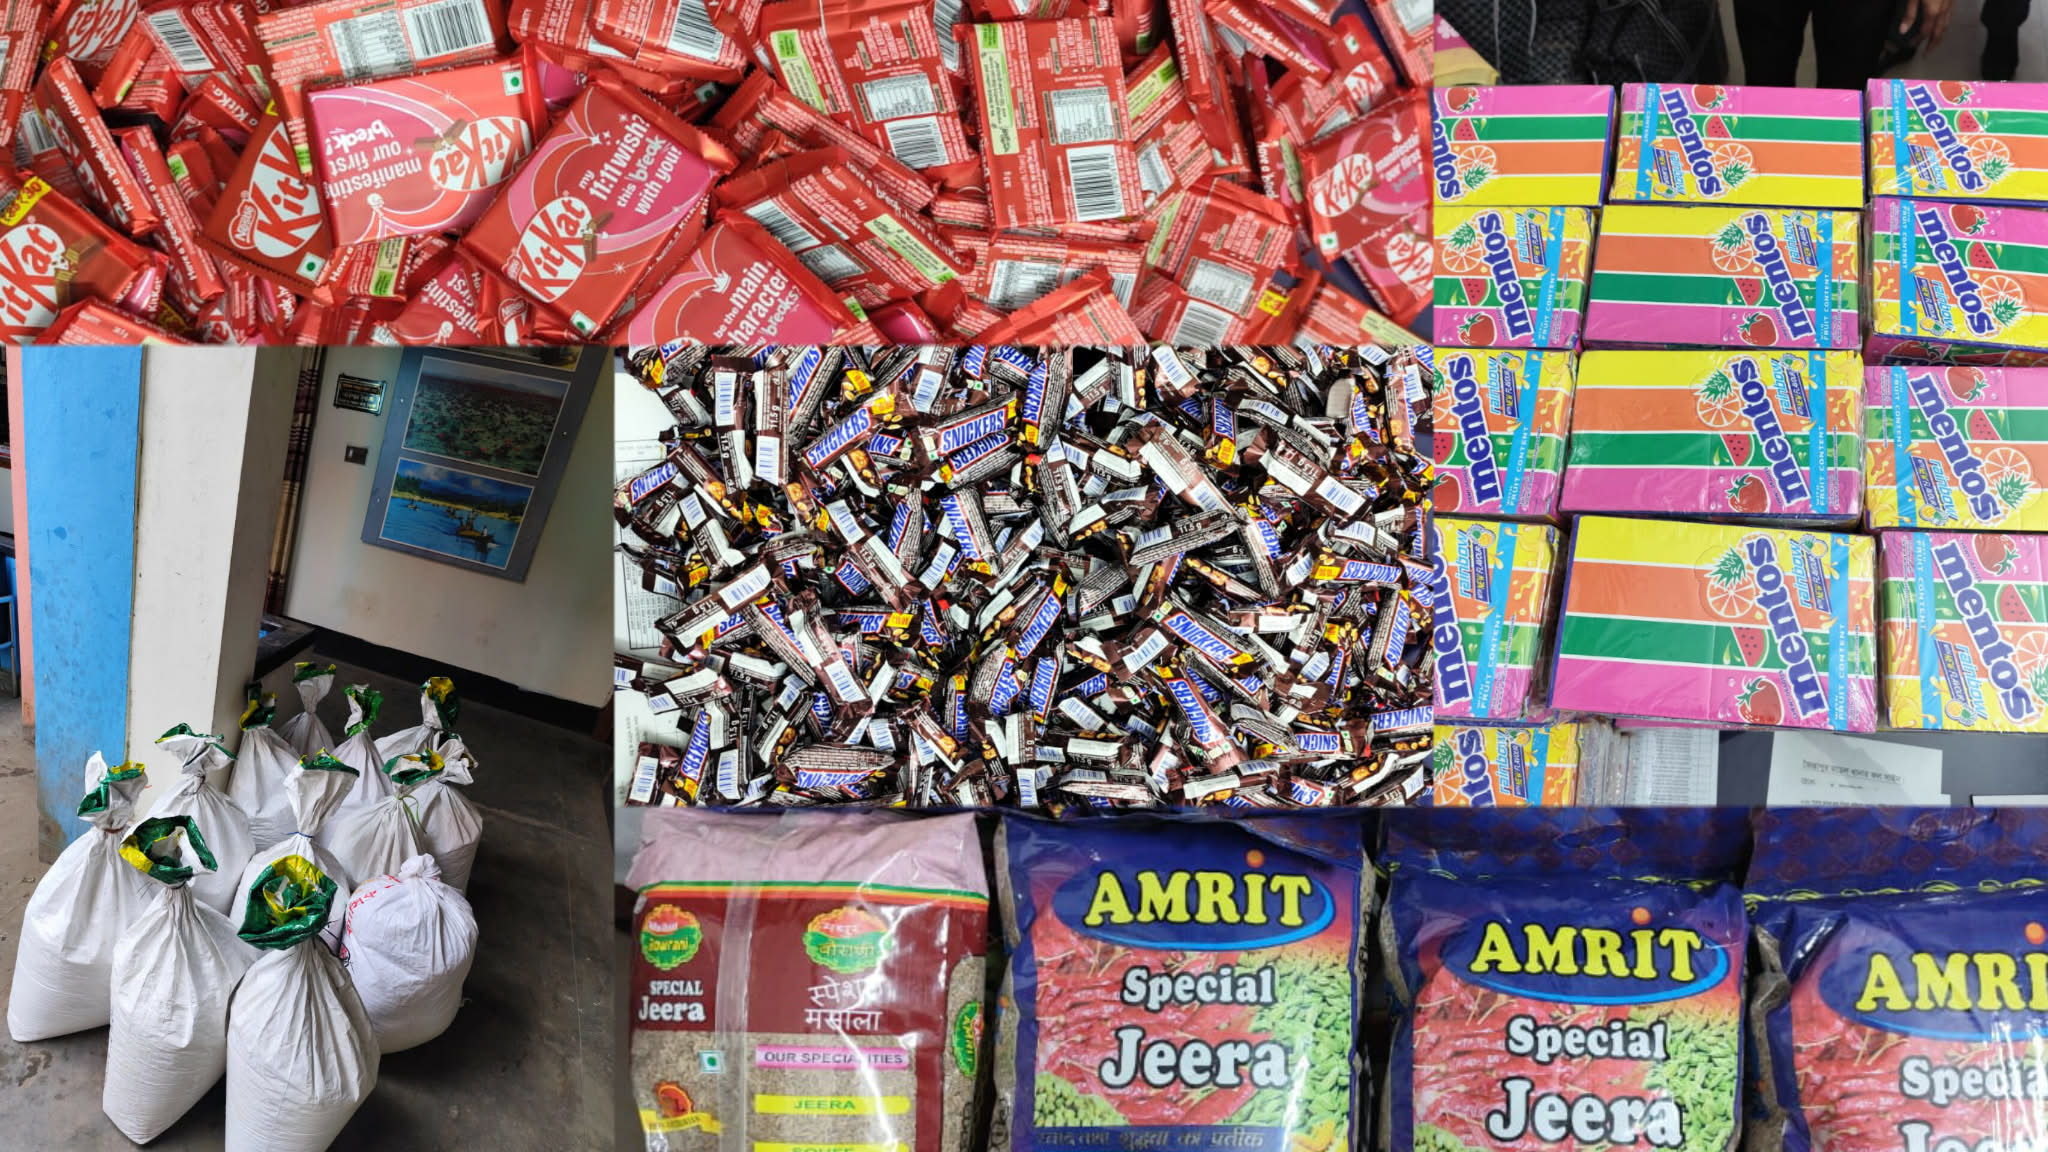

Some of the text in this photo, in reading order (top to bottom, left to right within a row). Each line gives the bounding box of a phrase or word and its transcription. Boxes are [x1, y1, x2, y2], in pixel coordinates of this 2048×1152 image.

[328, 141, 401, 177] our first
[433, 118, 530, 189] KitKat
[589, 114, 650, 201] 11:11 wish?
[1662, 89, 1722, 197] mentos
[1908, 85, 1983, 190] mentos
[578, 169, 595, 189] my
[616, 135, 666, 207] this break
[635, 181, 662, 215] with
[1318, 156, 1371, 215] KitKat
[330, 256, 349, 282] Have
[520, 199, 586, 297] KitKat
[1481, 213, 1533, 338] mentos
[1747, 214, 1813, 340] mentos
[1918, 210, 1995, 335] mentos
[713, 261, 769, 339] be the main
[1546, 272, 1555, 312] CONTENT
[1488, 358, 1502, 415] rainbow
[1771, 360, 1793, 415] rainbow
[807, 407, 870, 467] SNICKERS
[942, 409, 1006, 453] SNICKERS
[1451, 357, 1502, 504] mentos
[1733, 359, 1809, 505] mentos
[1908, 373, 2001, 522] mentos
[631, 463, 678, 502] SNICKE
[1510, 426, 1528, 505] FRUIT CONTENT
[1930, 459, 1957, 520] rainbow
[1344, 560, 1401, 582] SNICKERS
[1457, 532, 1472, 598] rainbow
[1791, 542, 1812, 608] rainbow
[1017, 595, 1061, 657] SNICKERS
[1747, 537, 1828, 718] mentos
[1918, 576, 1927, 630] CONTENT
[1933, 540, 2037, 720] mentos
[1168, 614, 1235, 662] SNICKERS
[1386, 601, 1410, 669] SNICKERS
[1480, 613, 1502, 709] FRUIT CONTENT
[1169, 680, 1211, 744] SNICKERS
[1956, 644, 1988, 720] rainbow
[683, 711, 710, 780] SNICKERS
[1297, 734, 1340, 751] SNICK
[1496, 731, 1510, 795] rainbow
[1083, 868, 1312, 927] AMRIT
[1470, 920, 1701, 981] AMRIT
[638, 996, 706, 1021] Jeera
[650, 979, 703, 996] SPECIAL
[1122, 965, 1276, 1012] Special
[1856, 952, 2048, 1012] AMRI
[804, 1007, 883, 1031] मसाला
[1506, 1015, 1669, 1064] Special
[764, 1052, 903, 1064] OUR SPECIAITIES
[1100, 1025, 1291, 1088] Jeera
[1899, 1055, 2048, 1108] Specia
[794, 1099, 856, 1110] JEERA
[1487, 1076, 1683, 1147] Jeera
